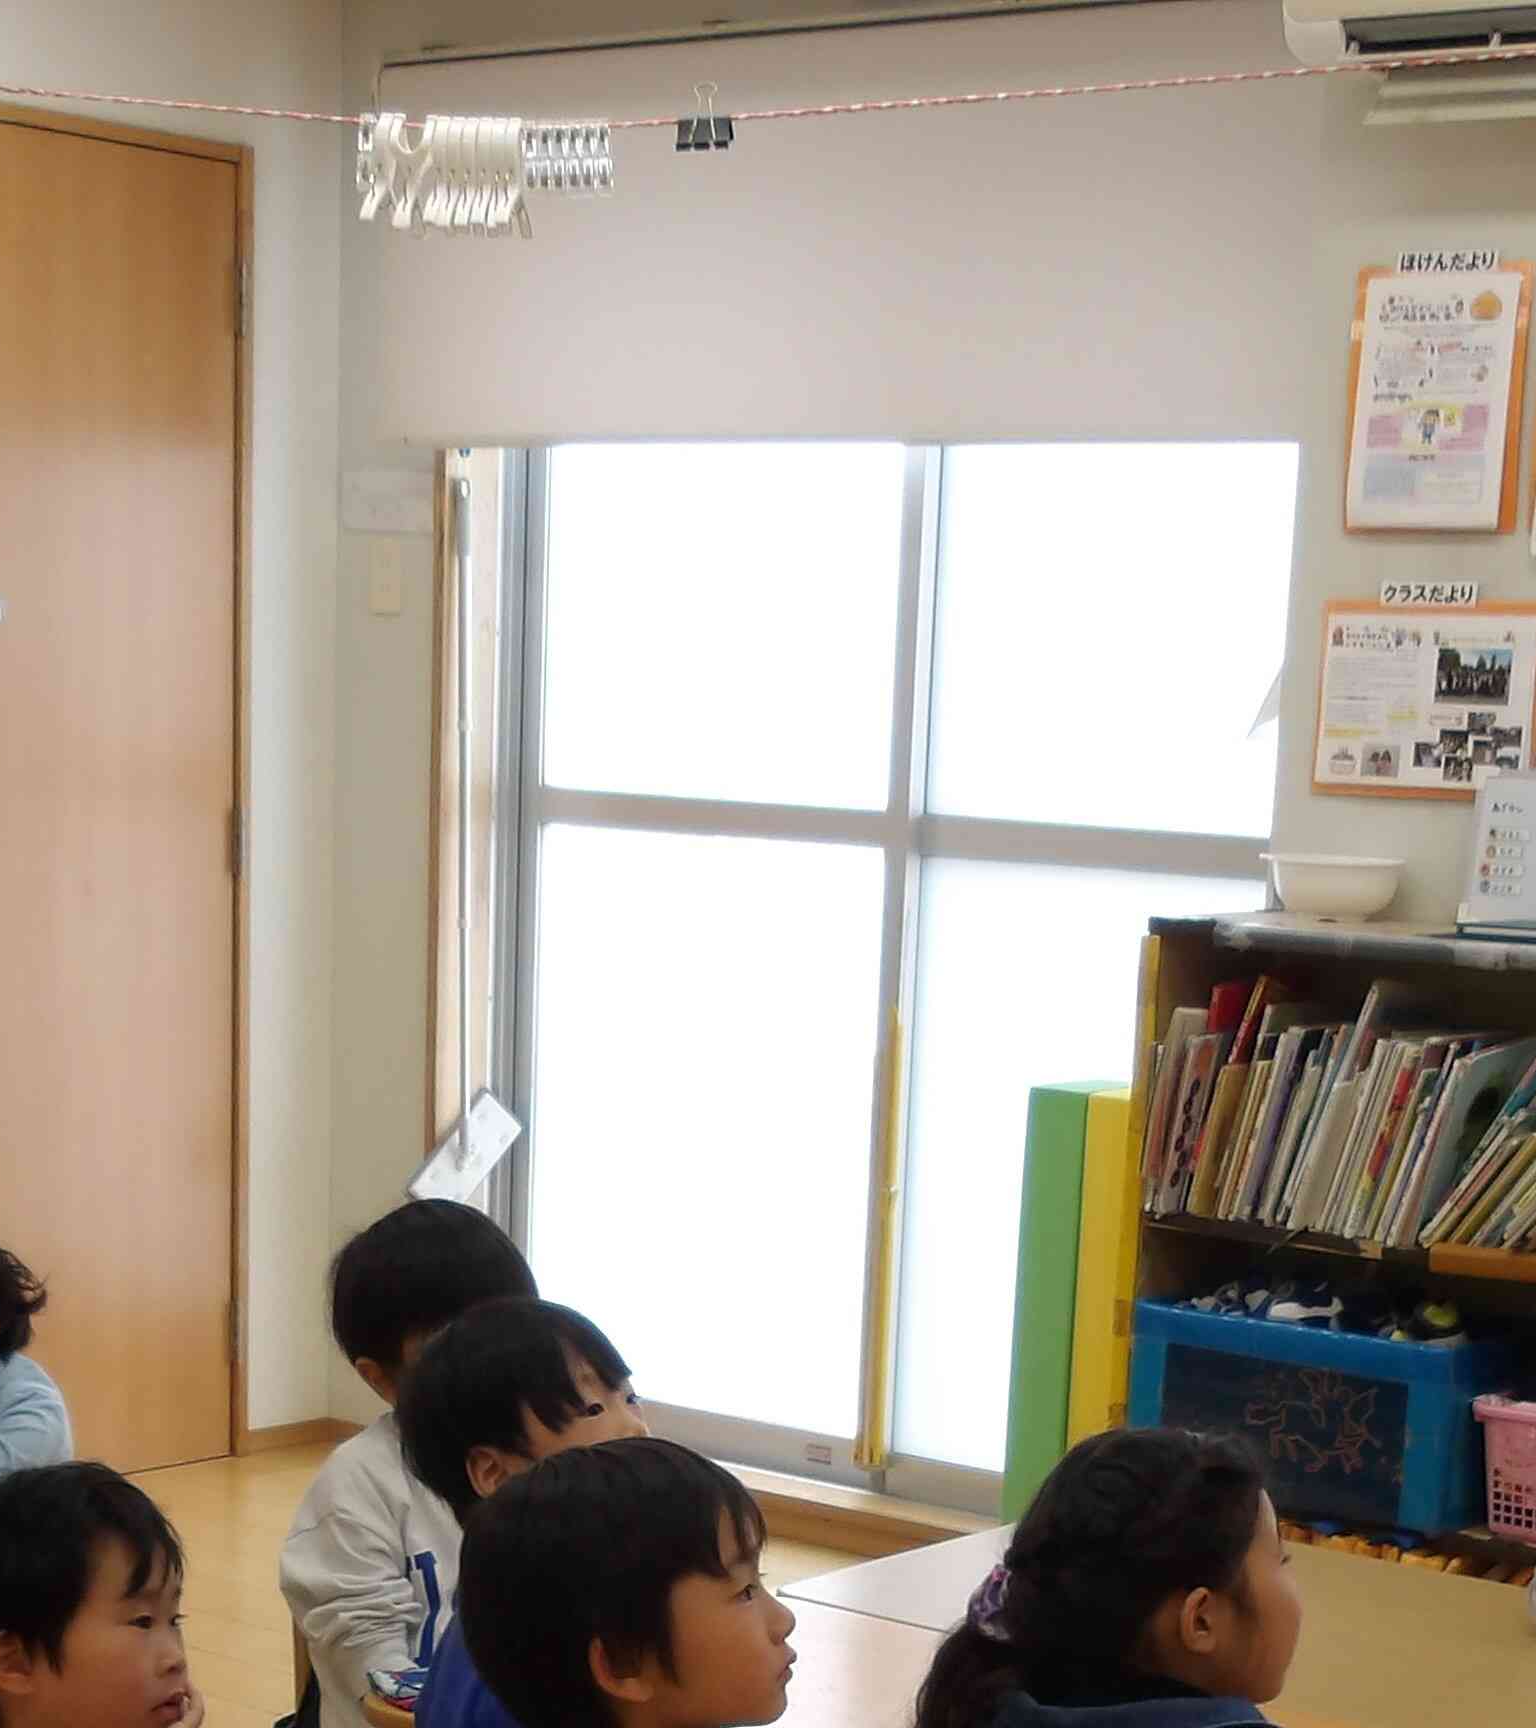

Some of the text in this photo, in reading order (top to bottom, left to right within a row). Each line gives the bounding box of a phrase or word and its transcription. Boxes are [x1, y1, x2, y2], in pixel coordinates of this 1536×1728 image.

[1400, 251, 1495, 272] ほけんだより
[1384, 584, 1473, 603] クラスだより
